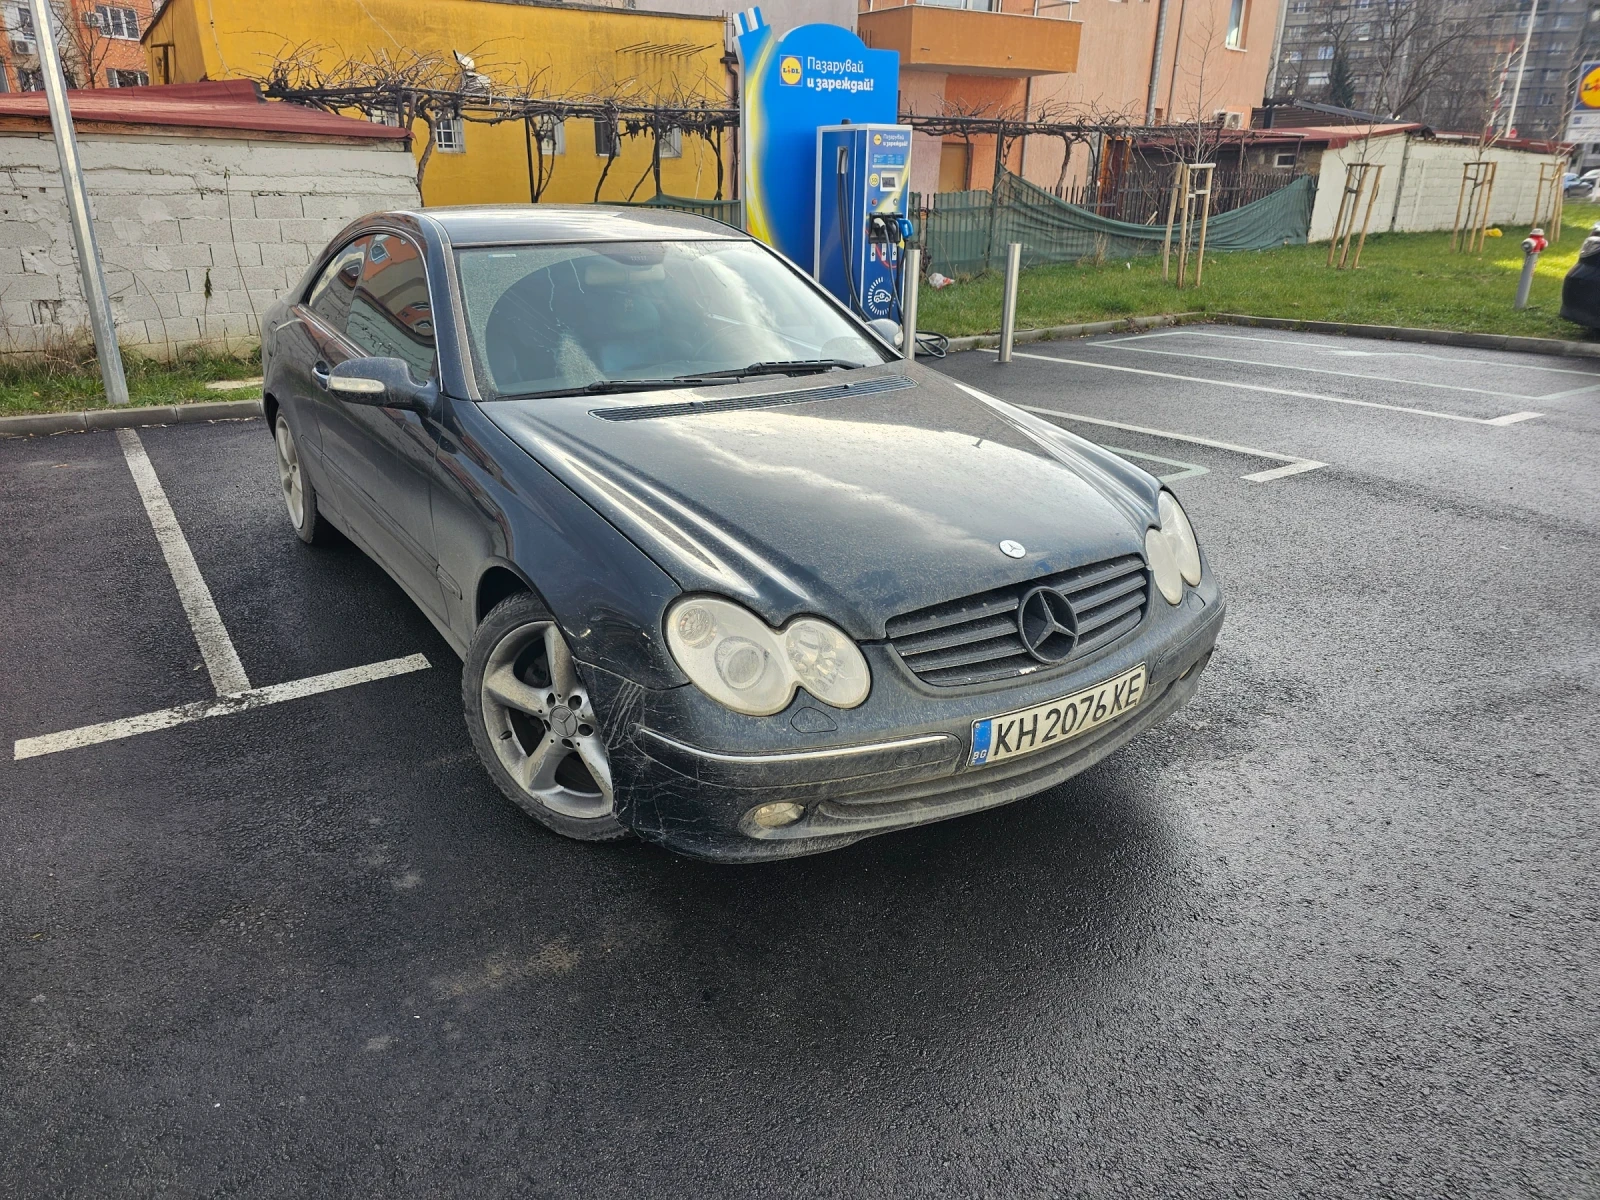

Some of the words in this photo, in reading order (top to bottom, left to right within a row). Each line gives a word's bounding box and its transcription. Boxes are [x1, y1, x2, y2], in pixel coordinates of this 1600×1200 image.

[807, 56, 864, 74] Пазарувай
[807, 77, 814, 88] и
[815, 77, 874, 93] зареждай!
[973, 750, 987, 760] BG
